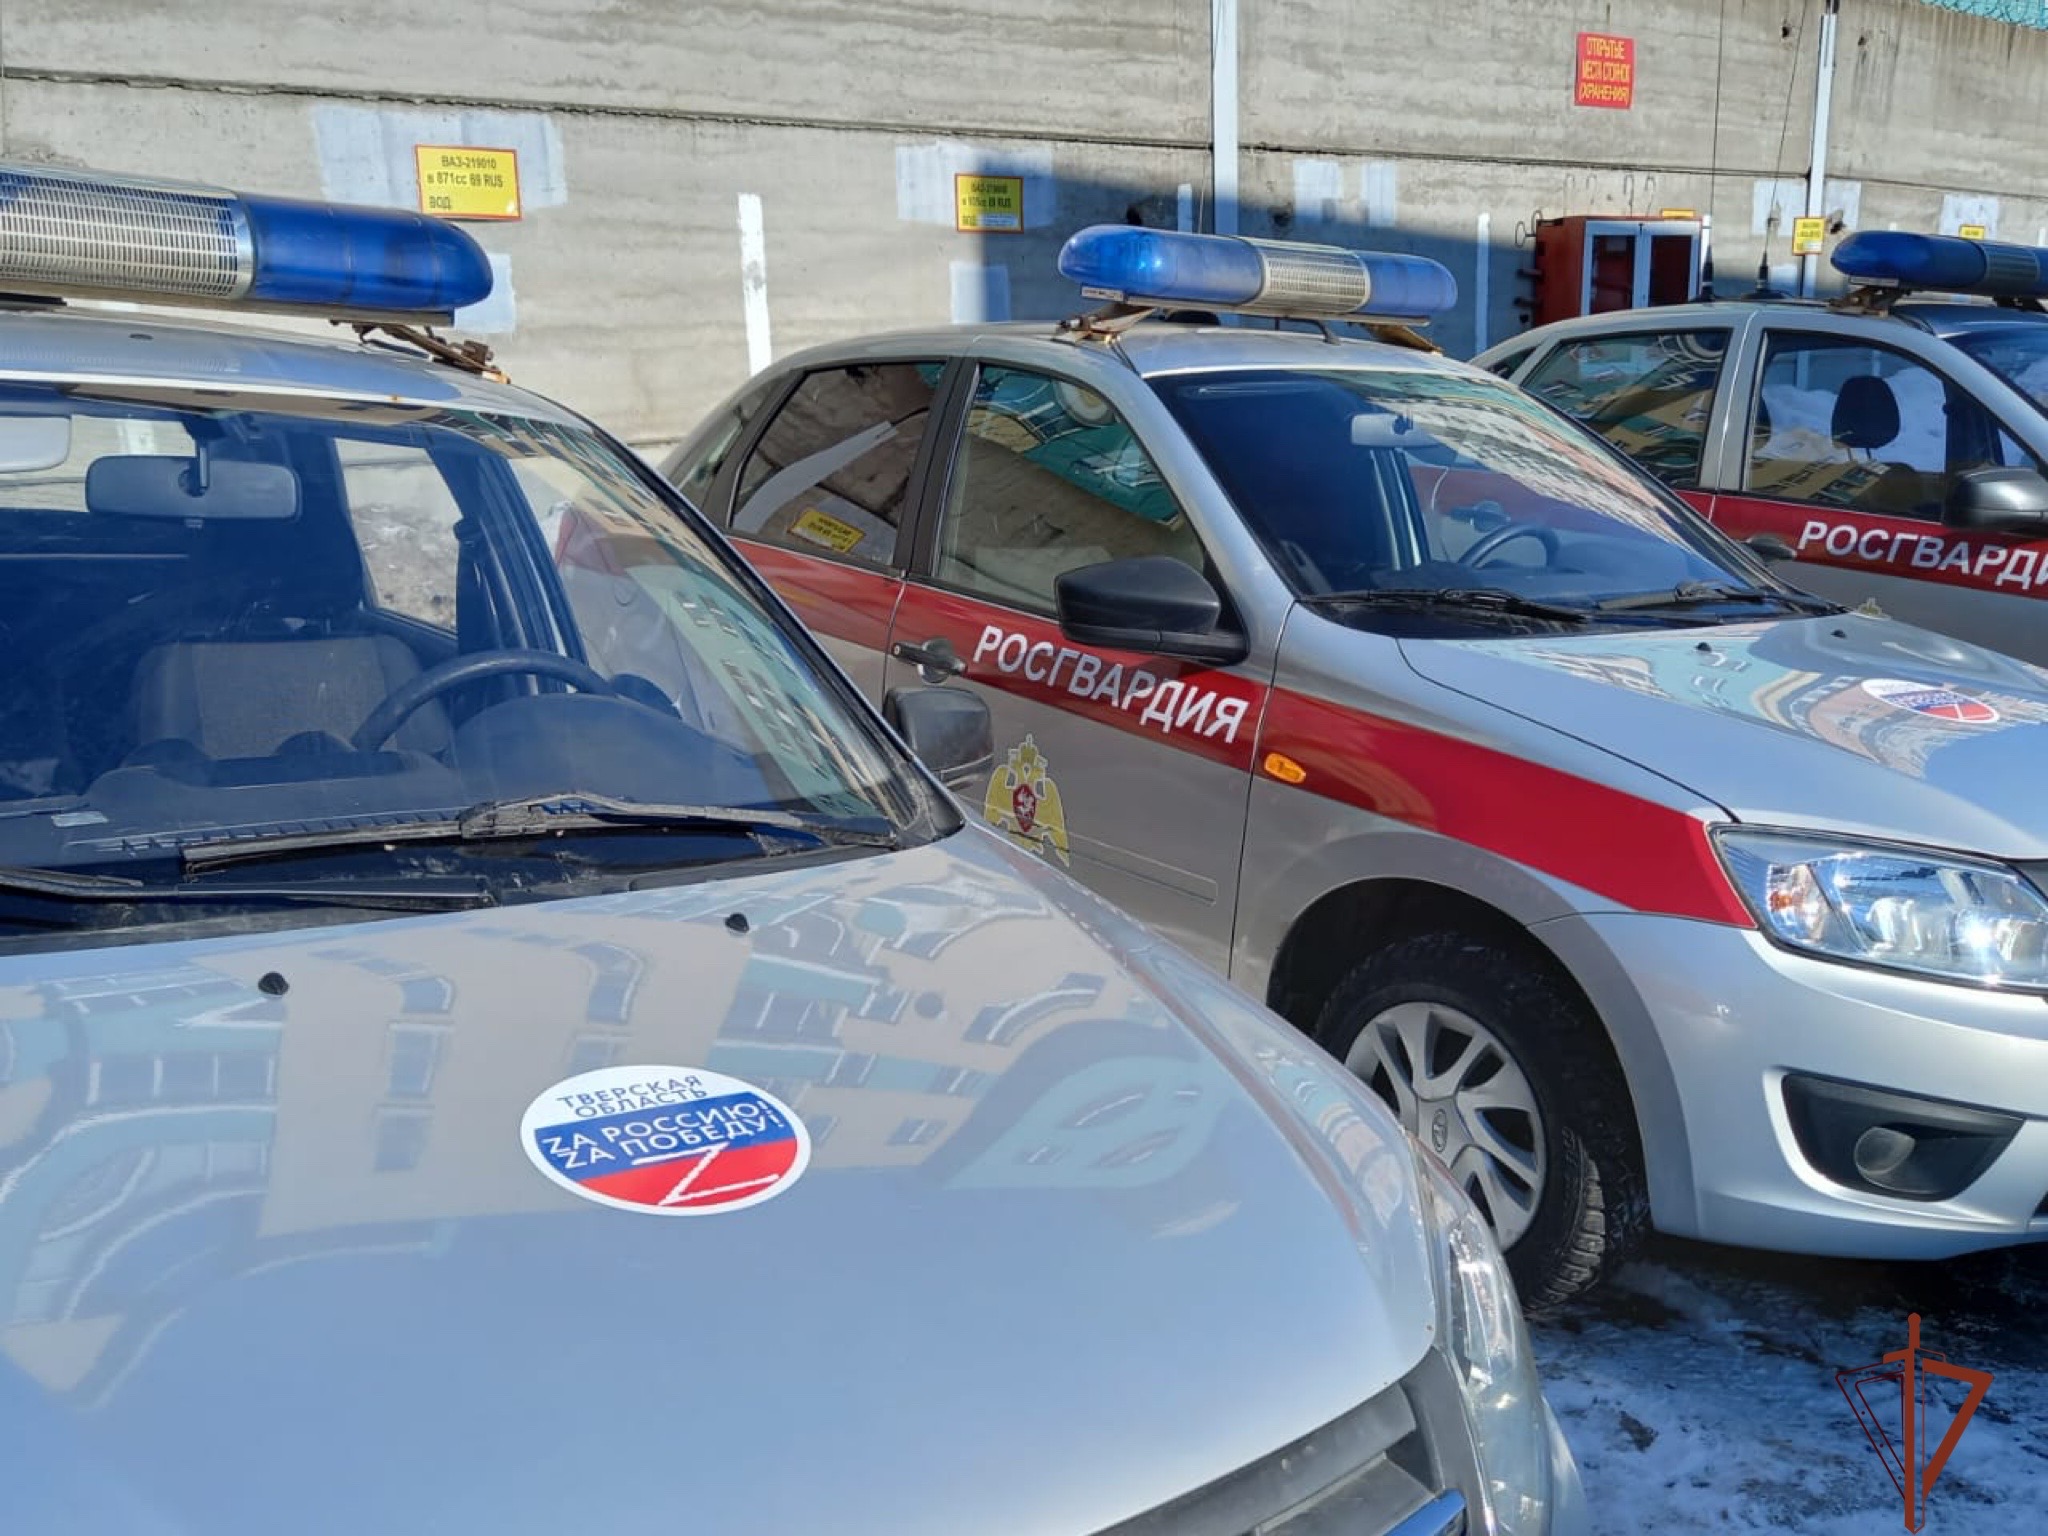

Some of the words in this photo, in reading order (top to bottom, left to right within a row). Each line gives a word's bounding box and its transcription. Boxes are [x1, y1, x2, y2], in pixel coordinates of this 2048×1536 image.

[484, 173, 503, 188] RUS
[973, 625, 1249, 744] РОСГВАРДИЯ
[557, 1075, 702, 1109] ТВЕРСКАЯ
[575, 1088, 707, 1119] ОБЛАСТЬ
[601, 1100, 773, 1143] РОССИЮ!
[619, 1113, 785, 1157] ПОБЕДУ!
[631, 1142, 780, 1206] Z
